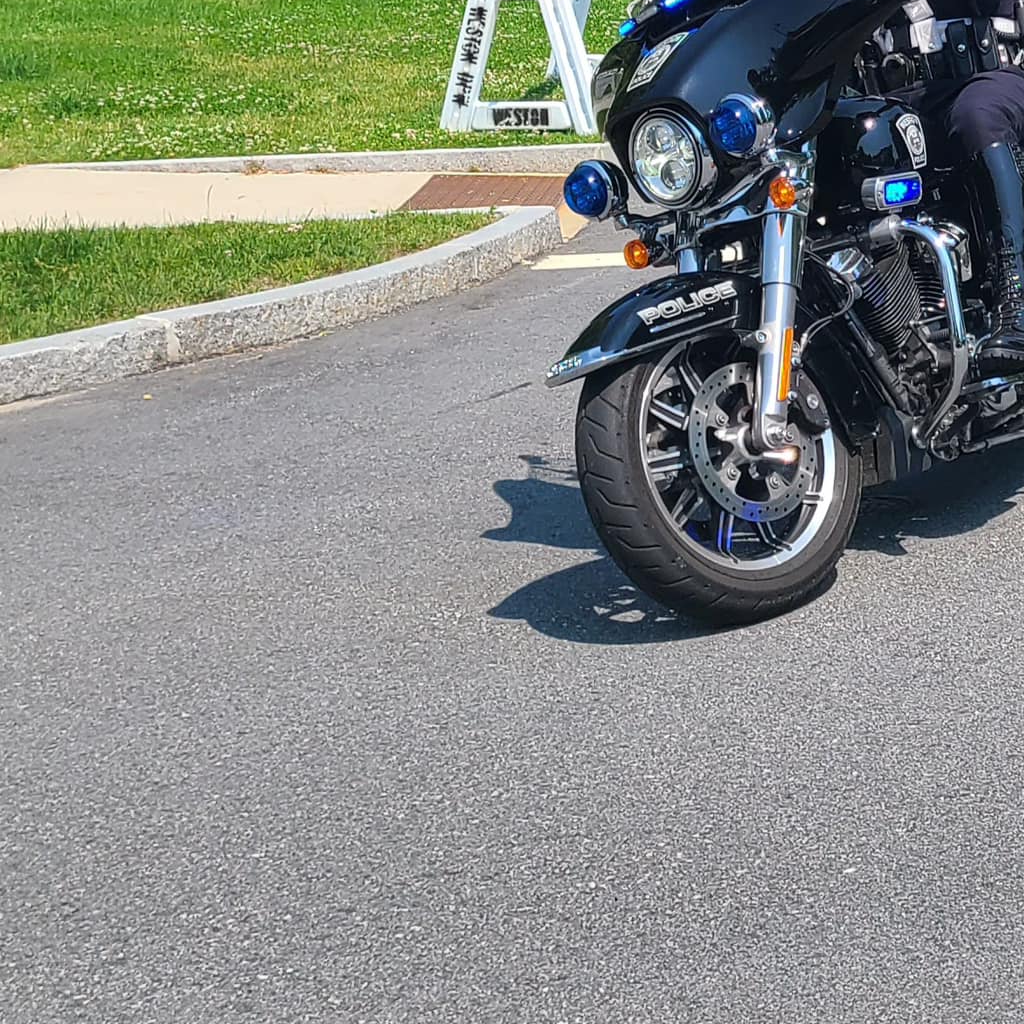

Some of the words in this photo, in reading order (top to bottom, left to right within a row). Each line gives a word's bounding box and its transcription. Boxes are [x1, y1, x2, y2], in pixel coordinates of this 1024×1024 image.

[460, 6, 488, 65] WESTON
[492, 108, 549, 126] WESTON
[637, 280, 738, 326] POLICE
